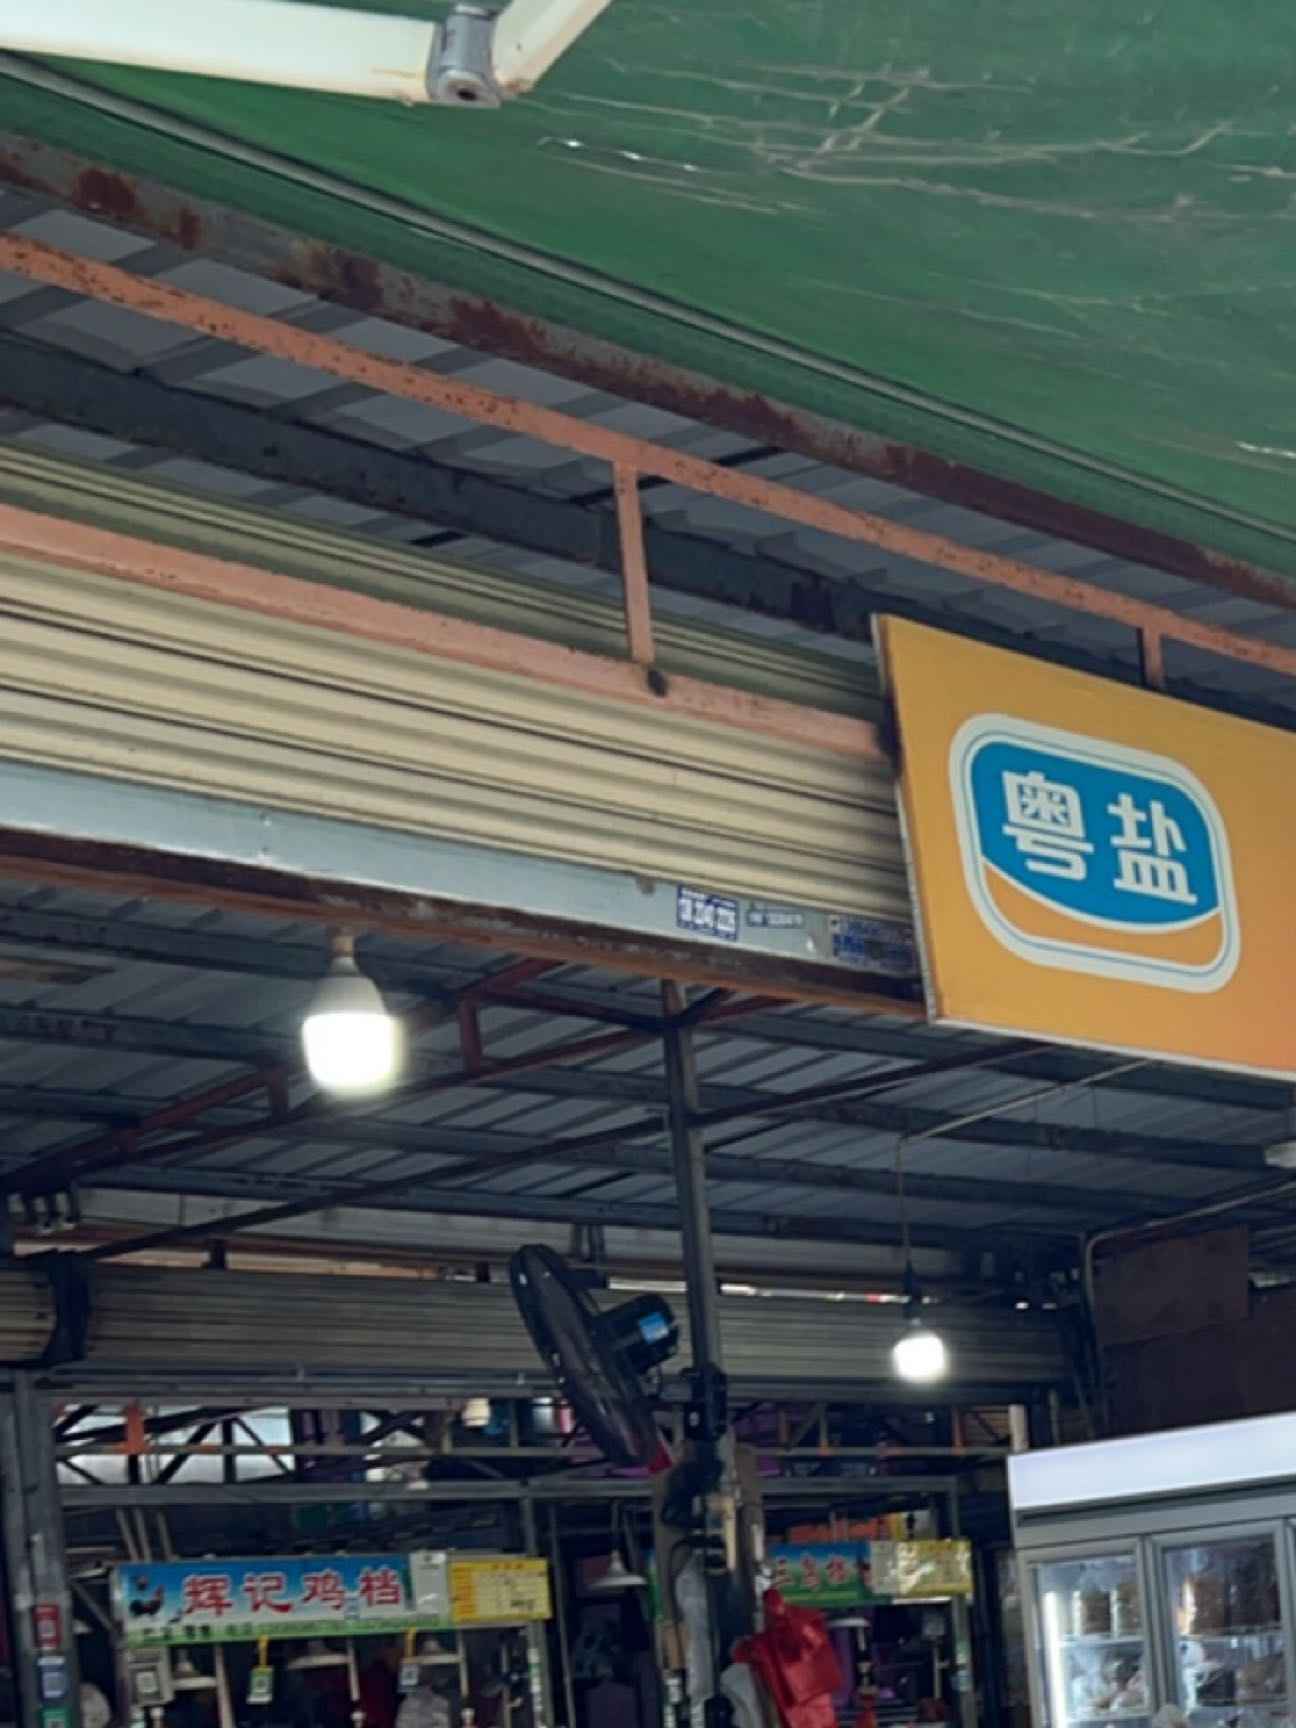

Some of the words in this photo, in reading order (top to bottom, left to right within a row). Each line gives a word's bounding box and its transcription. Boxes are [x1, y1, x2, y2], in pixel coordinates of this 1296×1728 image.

[1002, 770, 1198, 905] 粤盐
[183, 1564, 402, 1617] 辉记鸡档
